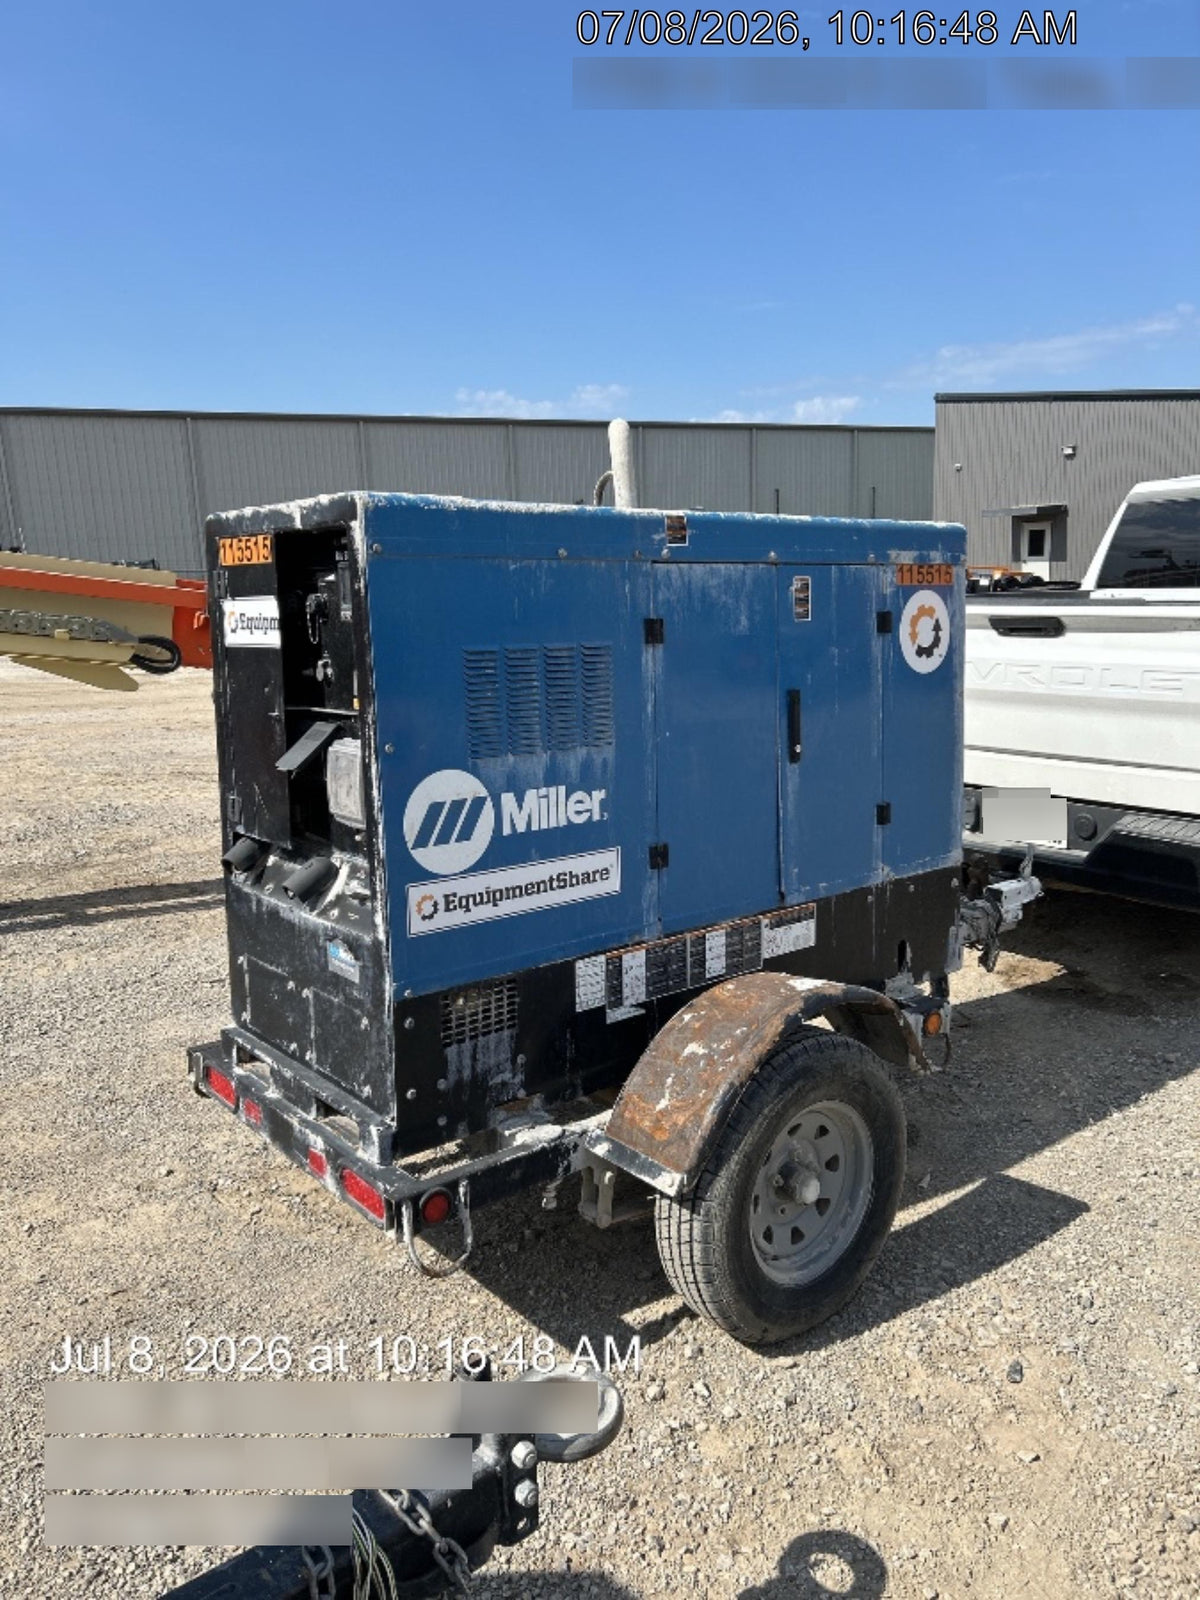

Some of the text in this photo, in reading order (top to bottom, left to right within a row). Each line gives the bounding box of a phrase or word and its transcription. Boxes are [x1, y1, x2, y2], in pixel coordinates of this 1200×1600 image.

[221, 536, 272, 564] 115515
[898, 564, 952, 585] 115515
[965, 660, 1200, 694] VROLE
[501, 785, 607, 837] Miller
[443, 866, 611, 914] EquipmentShare
